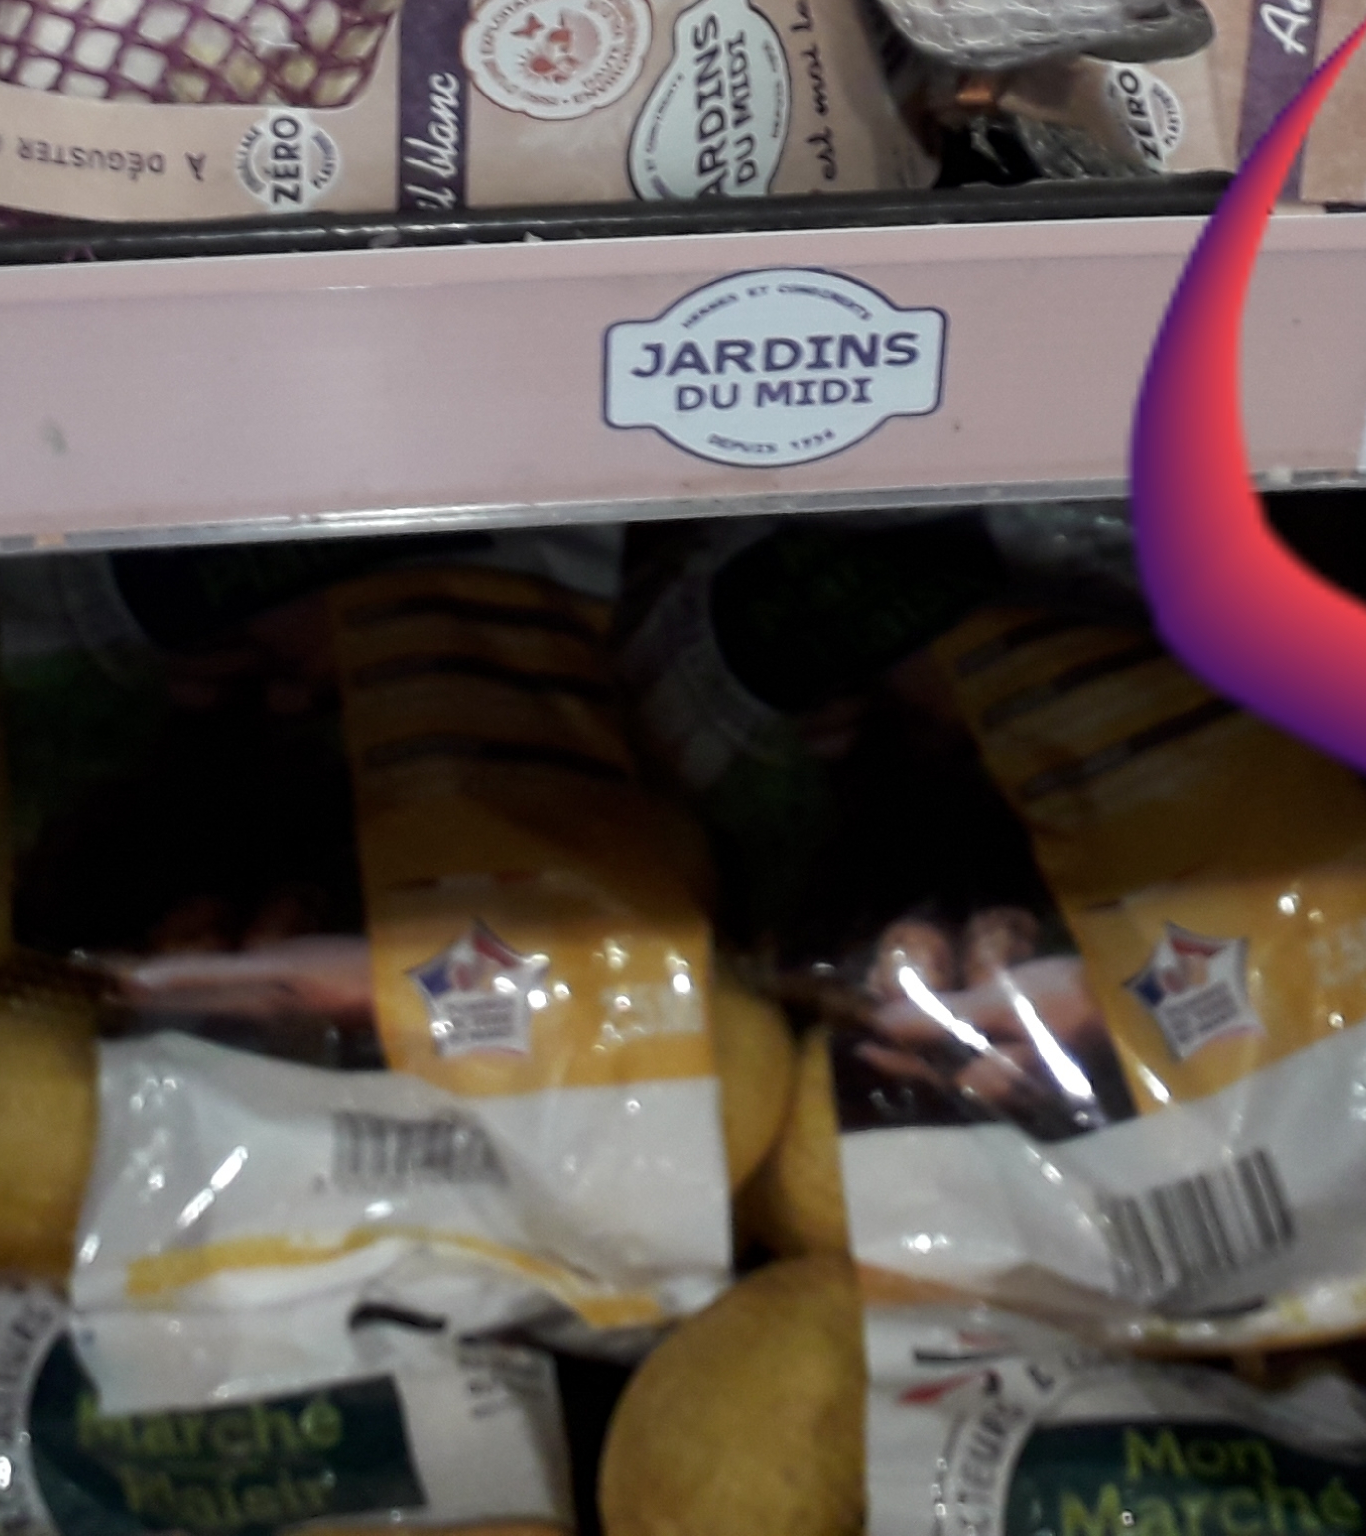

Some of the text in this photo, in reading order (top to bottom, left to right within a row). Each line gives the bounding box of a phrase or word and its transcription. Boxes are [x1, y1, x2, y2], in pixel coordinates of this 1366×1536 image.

[403, 71, 461, 180] blanc
[690, 13, 728, 199] ARDINS
[728, 30, 759, 187] DU MIDI
[269, 114, 305, 206] ZÉRO
[628, 331, 923, 379] JARDINS
[673, 375, 875, 413] DU MIDI
[1122, 1424, 1276, 1482] Mon
